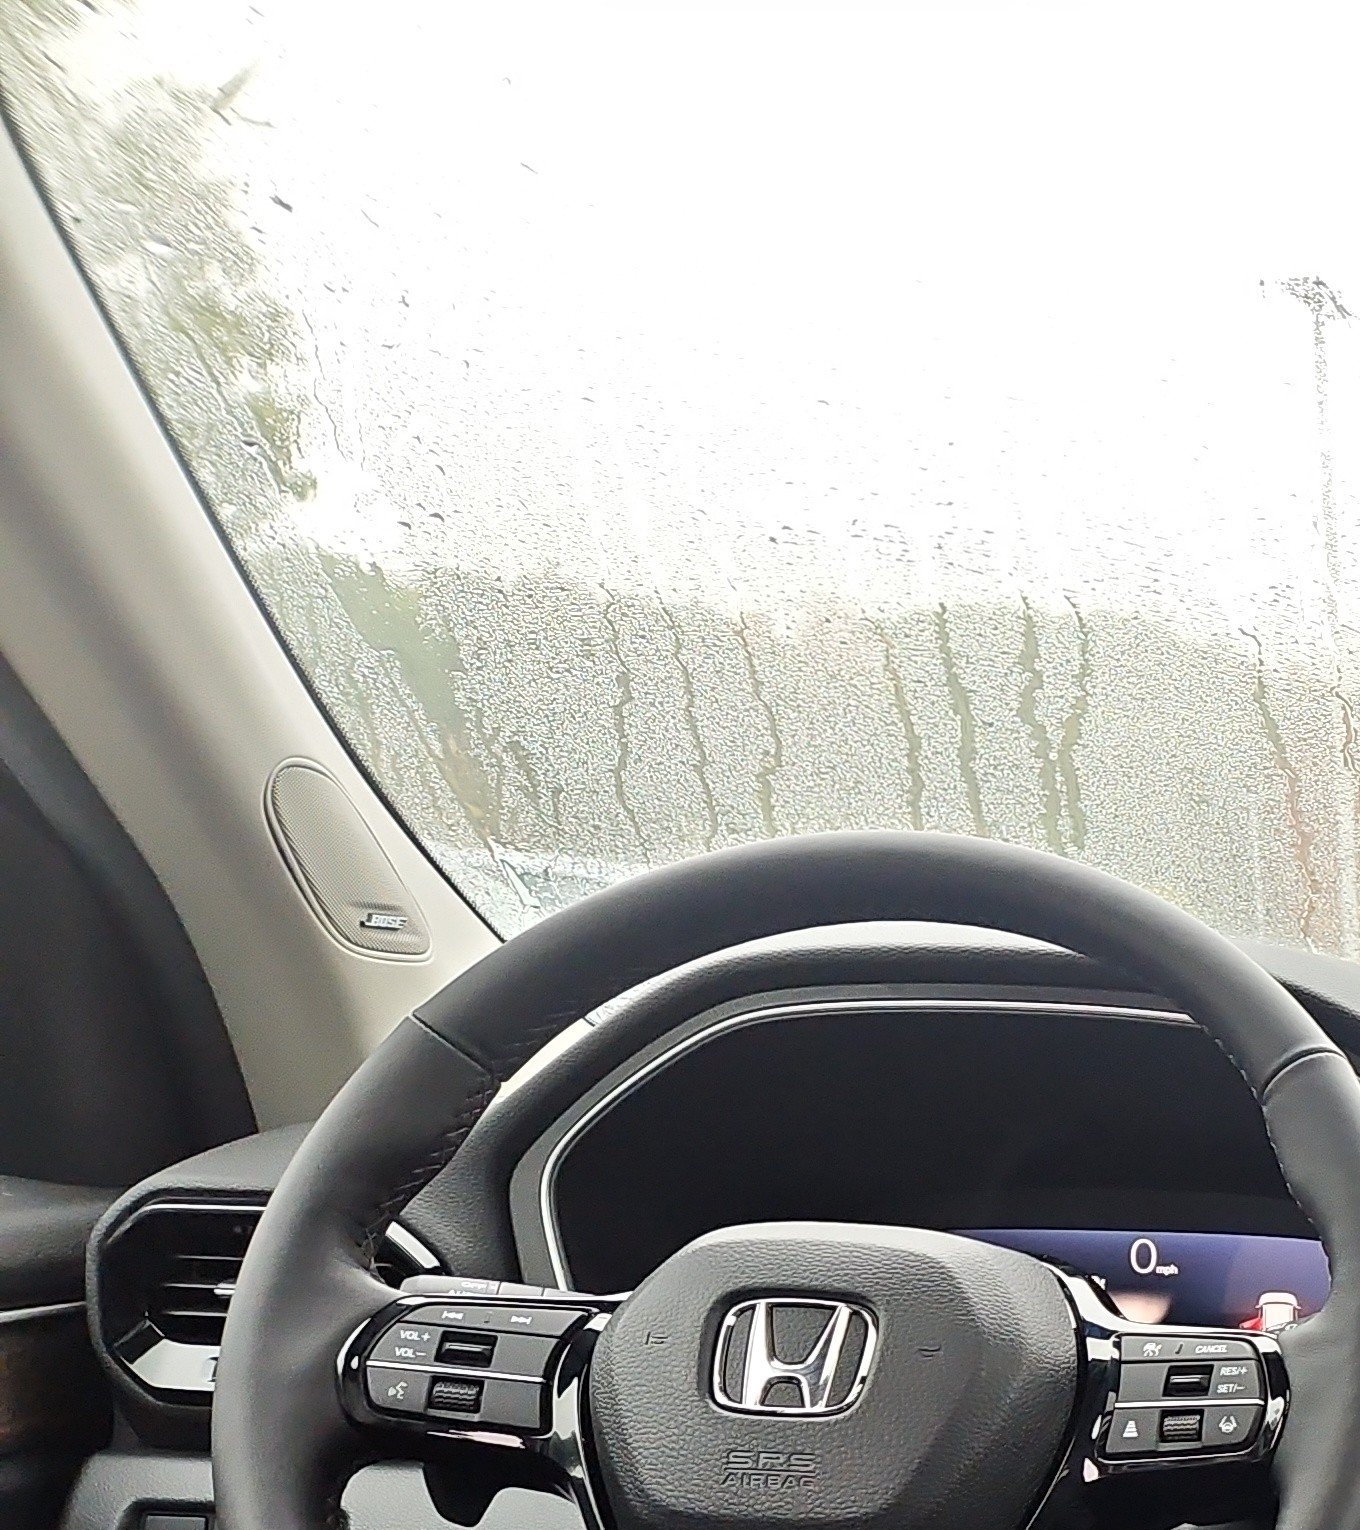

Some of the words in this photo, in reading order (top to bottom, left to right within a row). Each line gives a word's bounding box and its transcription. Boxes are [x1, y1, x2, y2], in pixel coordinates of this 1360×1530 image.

[363, 914, 408, 929] BOSE
[1129, 1238, 1158, 1275] 0
[1155, 1263, 1179, 1276] mph
[1195, 1344, 1228, 1354] CANCEL
[725, 1450, 817, 1471] SRS
[721, 1473, 816, 1488] AIRBAG
